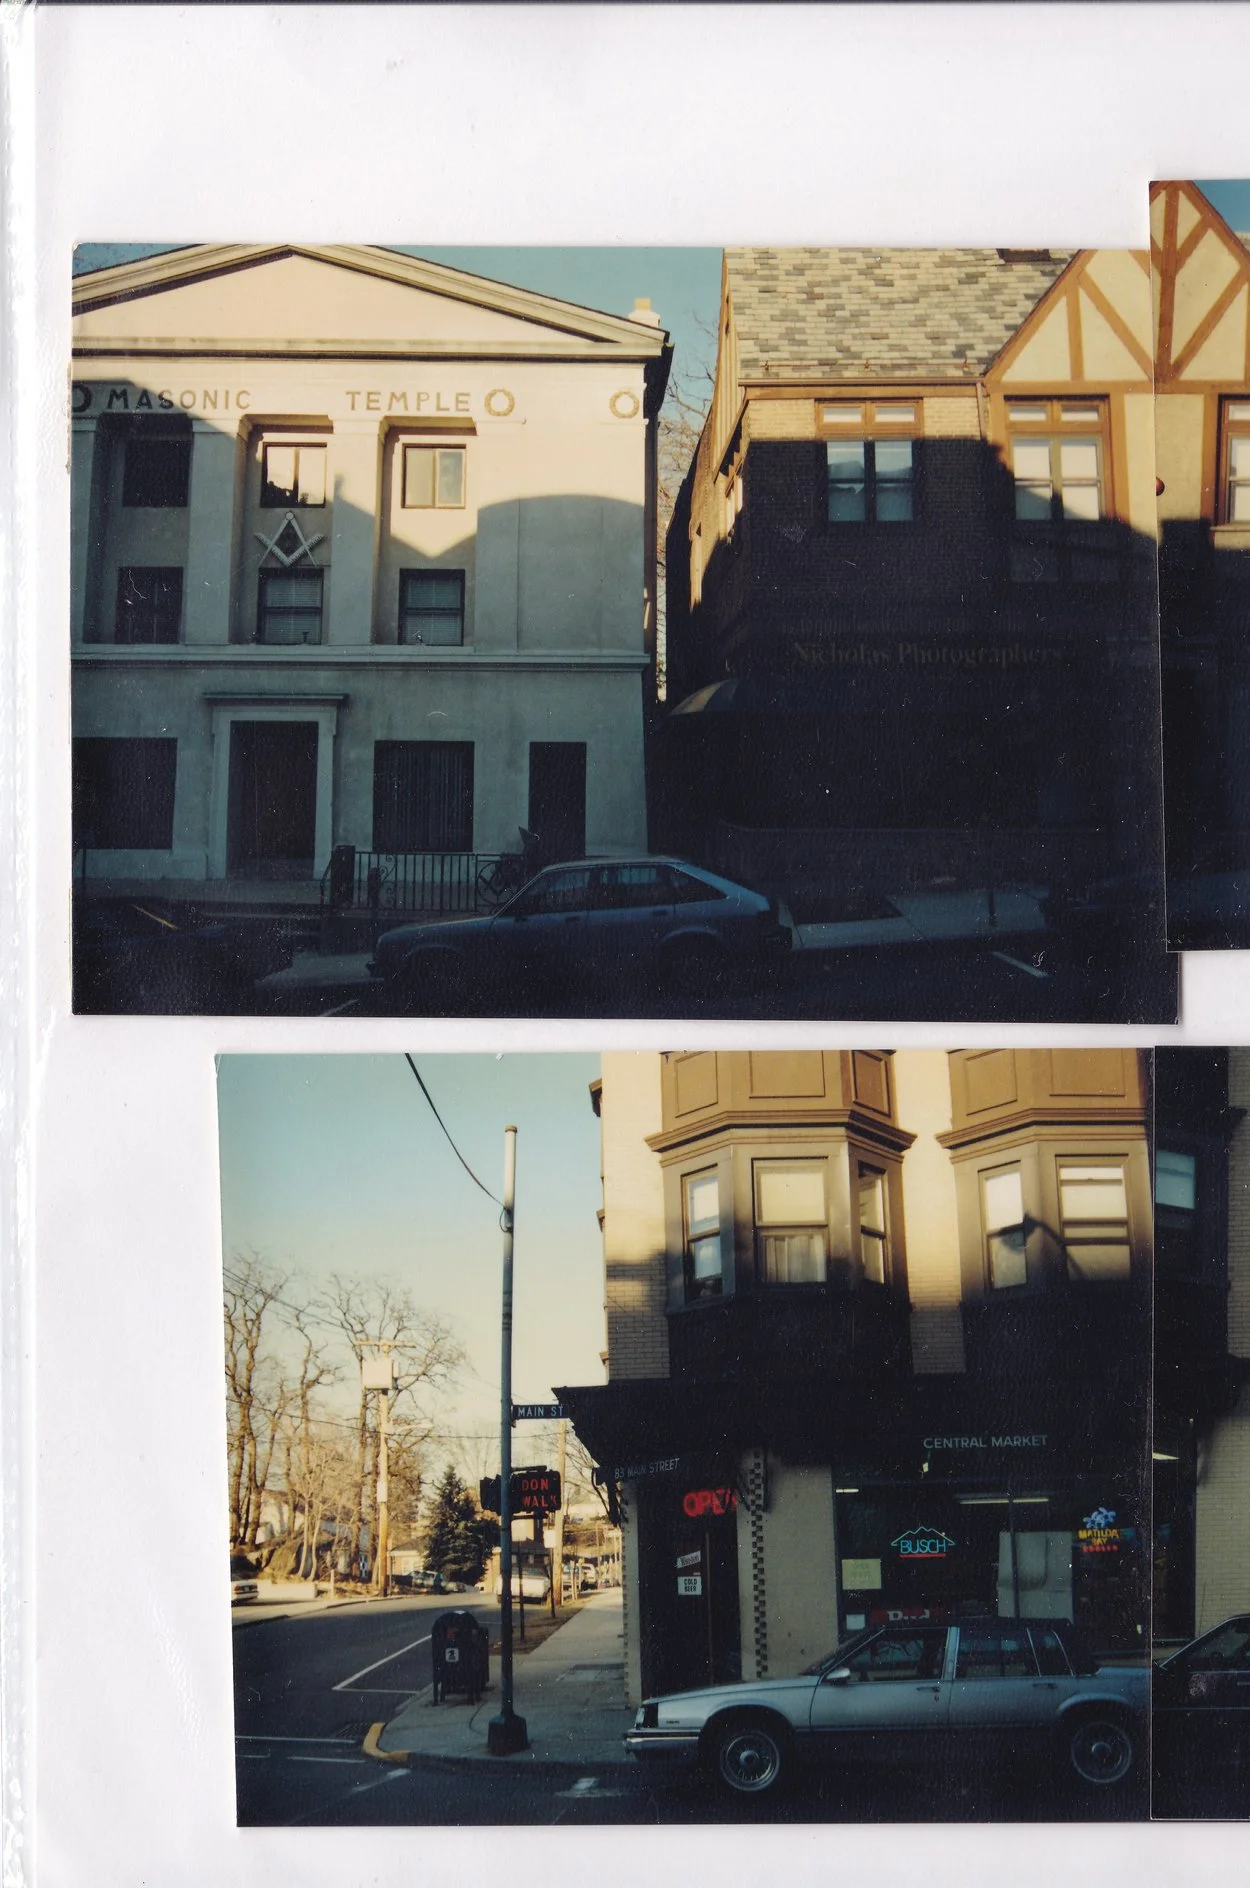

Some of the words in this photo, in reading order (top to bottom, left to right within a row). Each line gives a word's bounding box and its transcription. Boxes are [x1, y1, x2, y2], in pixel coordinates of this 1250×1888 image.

[107, 388, 251, 412] MASONIC
[345, 390, 472, 413] TEMPLE
[793, 641, 890, 666] Nicholas
[899, 641, 1062, 670] Photographers
[517, 1406, 545, 1418] MAIN
[550, 1404, 565, 1417] ST
[923, 1435, 987, 1450] CENTRAL
[990, 1434, 1049, 1449] MARKET
[614, 1467, 625, 1480] 83
[627, 1464, 647, 1478] MAIN
[649, 1457, 681, 1474] STREET
[521, 1494, 558, 1508] WALK
[899, 1538, 947, 1555] BUSCH
[683, 1578, 698, 1586] COLD
[684, 1585, 697, 1593] BEER
